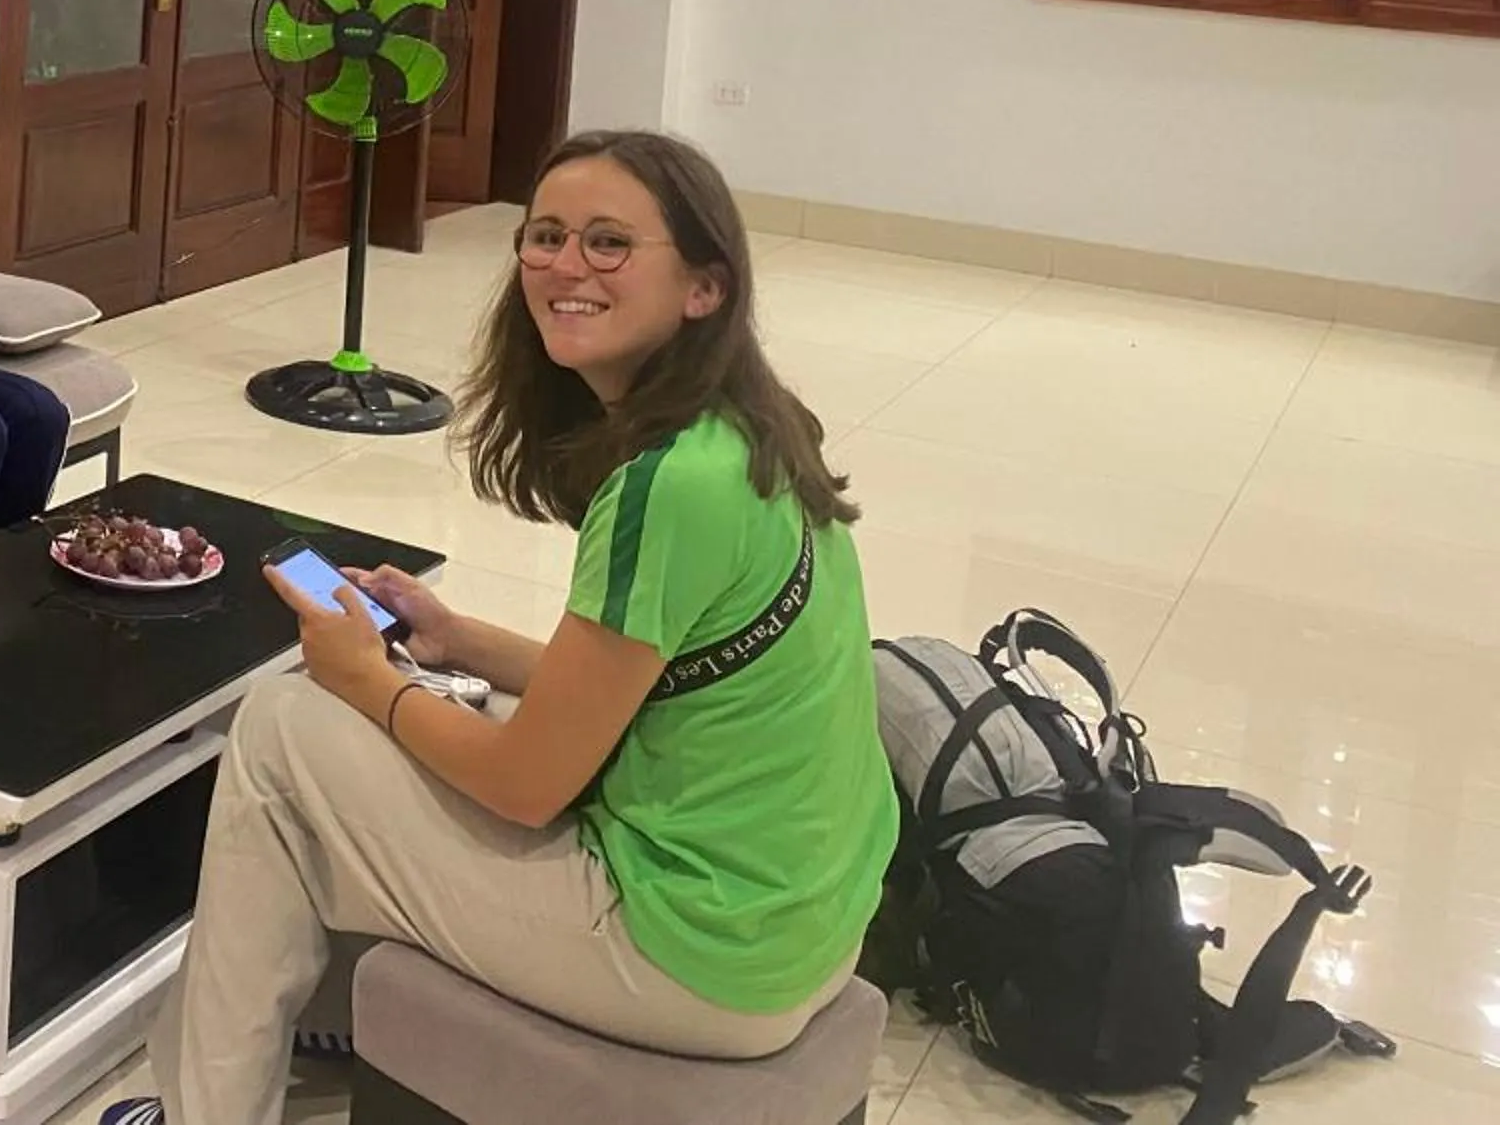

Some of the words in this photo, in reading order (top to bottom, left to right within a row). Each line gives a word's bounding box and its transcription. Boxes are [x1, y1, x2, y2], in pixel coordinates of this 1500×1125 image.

[780, 584, 803, 613] de
[722, 613, 784, 661] Paris
[675, 656, 723, 679] Les
